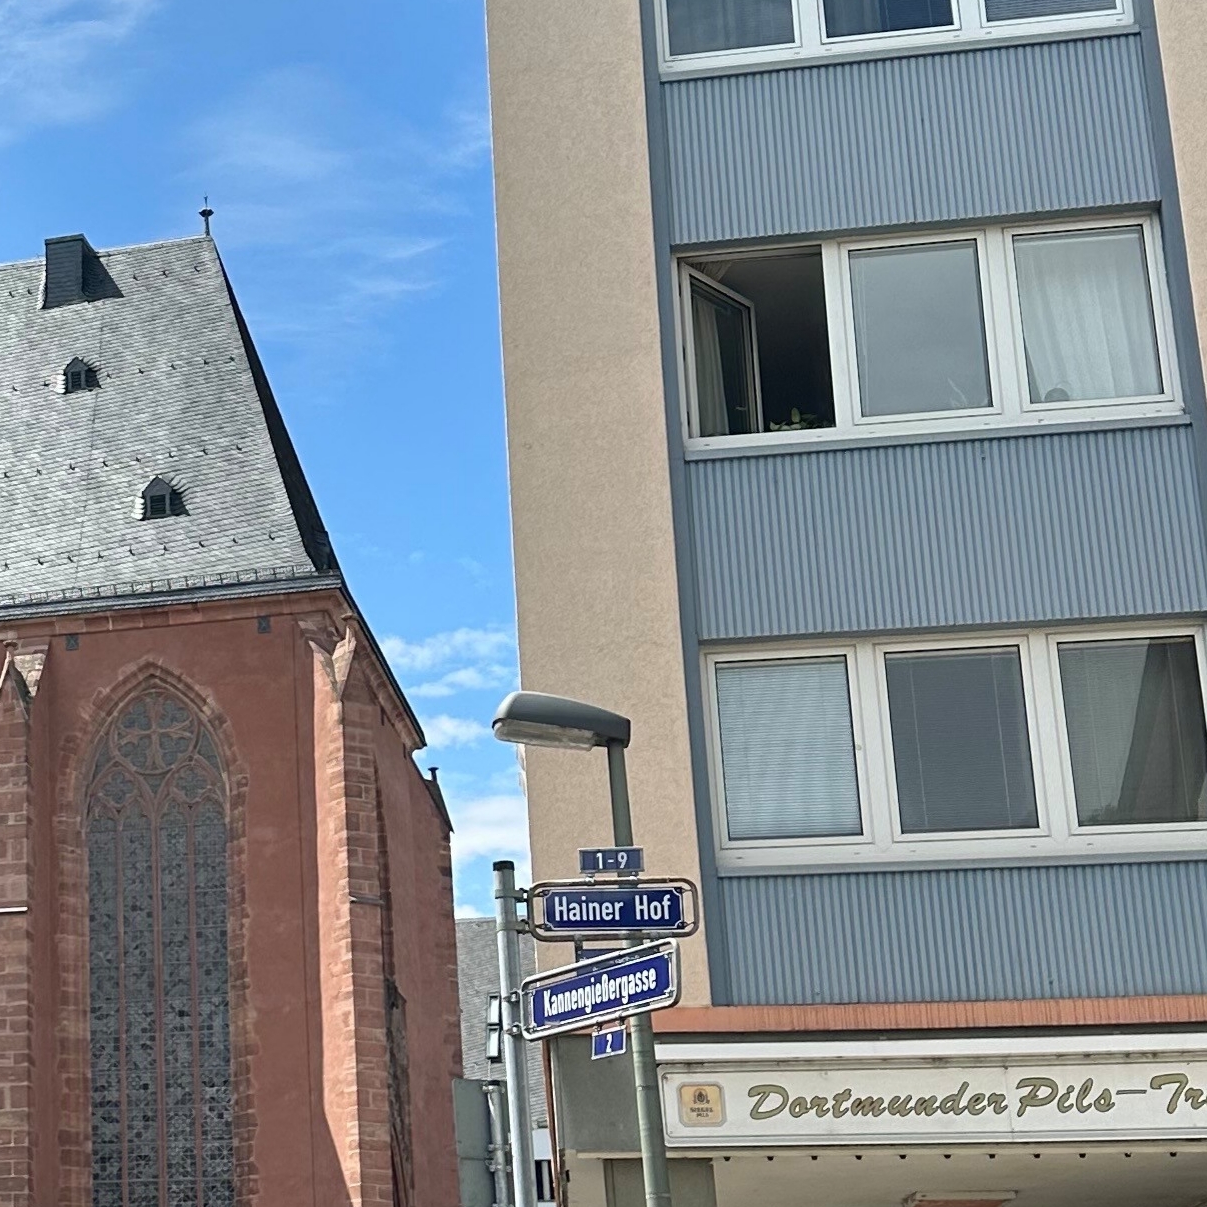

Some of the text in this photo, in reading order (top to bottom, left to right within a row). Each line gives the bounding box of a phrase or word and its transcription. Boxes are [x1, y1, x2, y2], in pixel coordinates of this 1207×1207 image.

[554, 893, 672, 922] Hainer Hof
[543, 967, 657, 1018] Kannengießergasse
[605, 1033, 613, 1054] 2
[746, 1073, 1207, 1121] Dortmunder Pils-Tr
